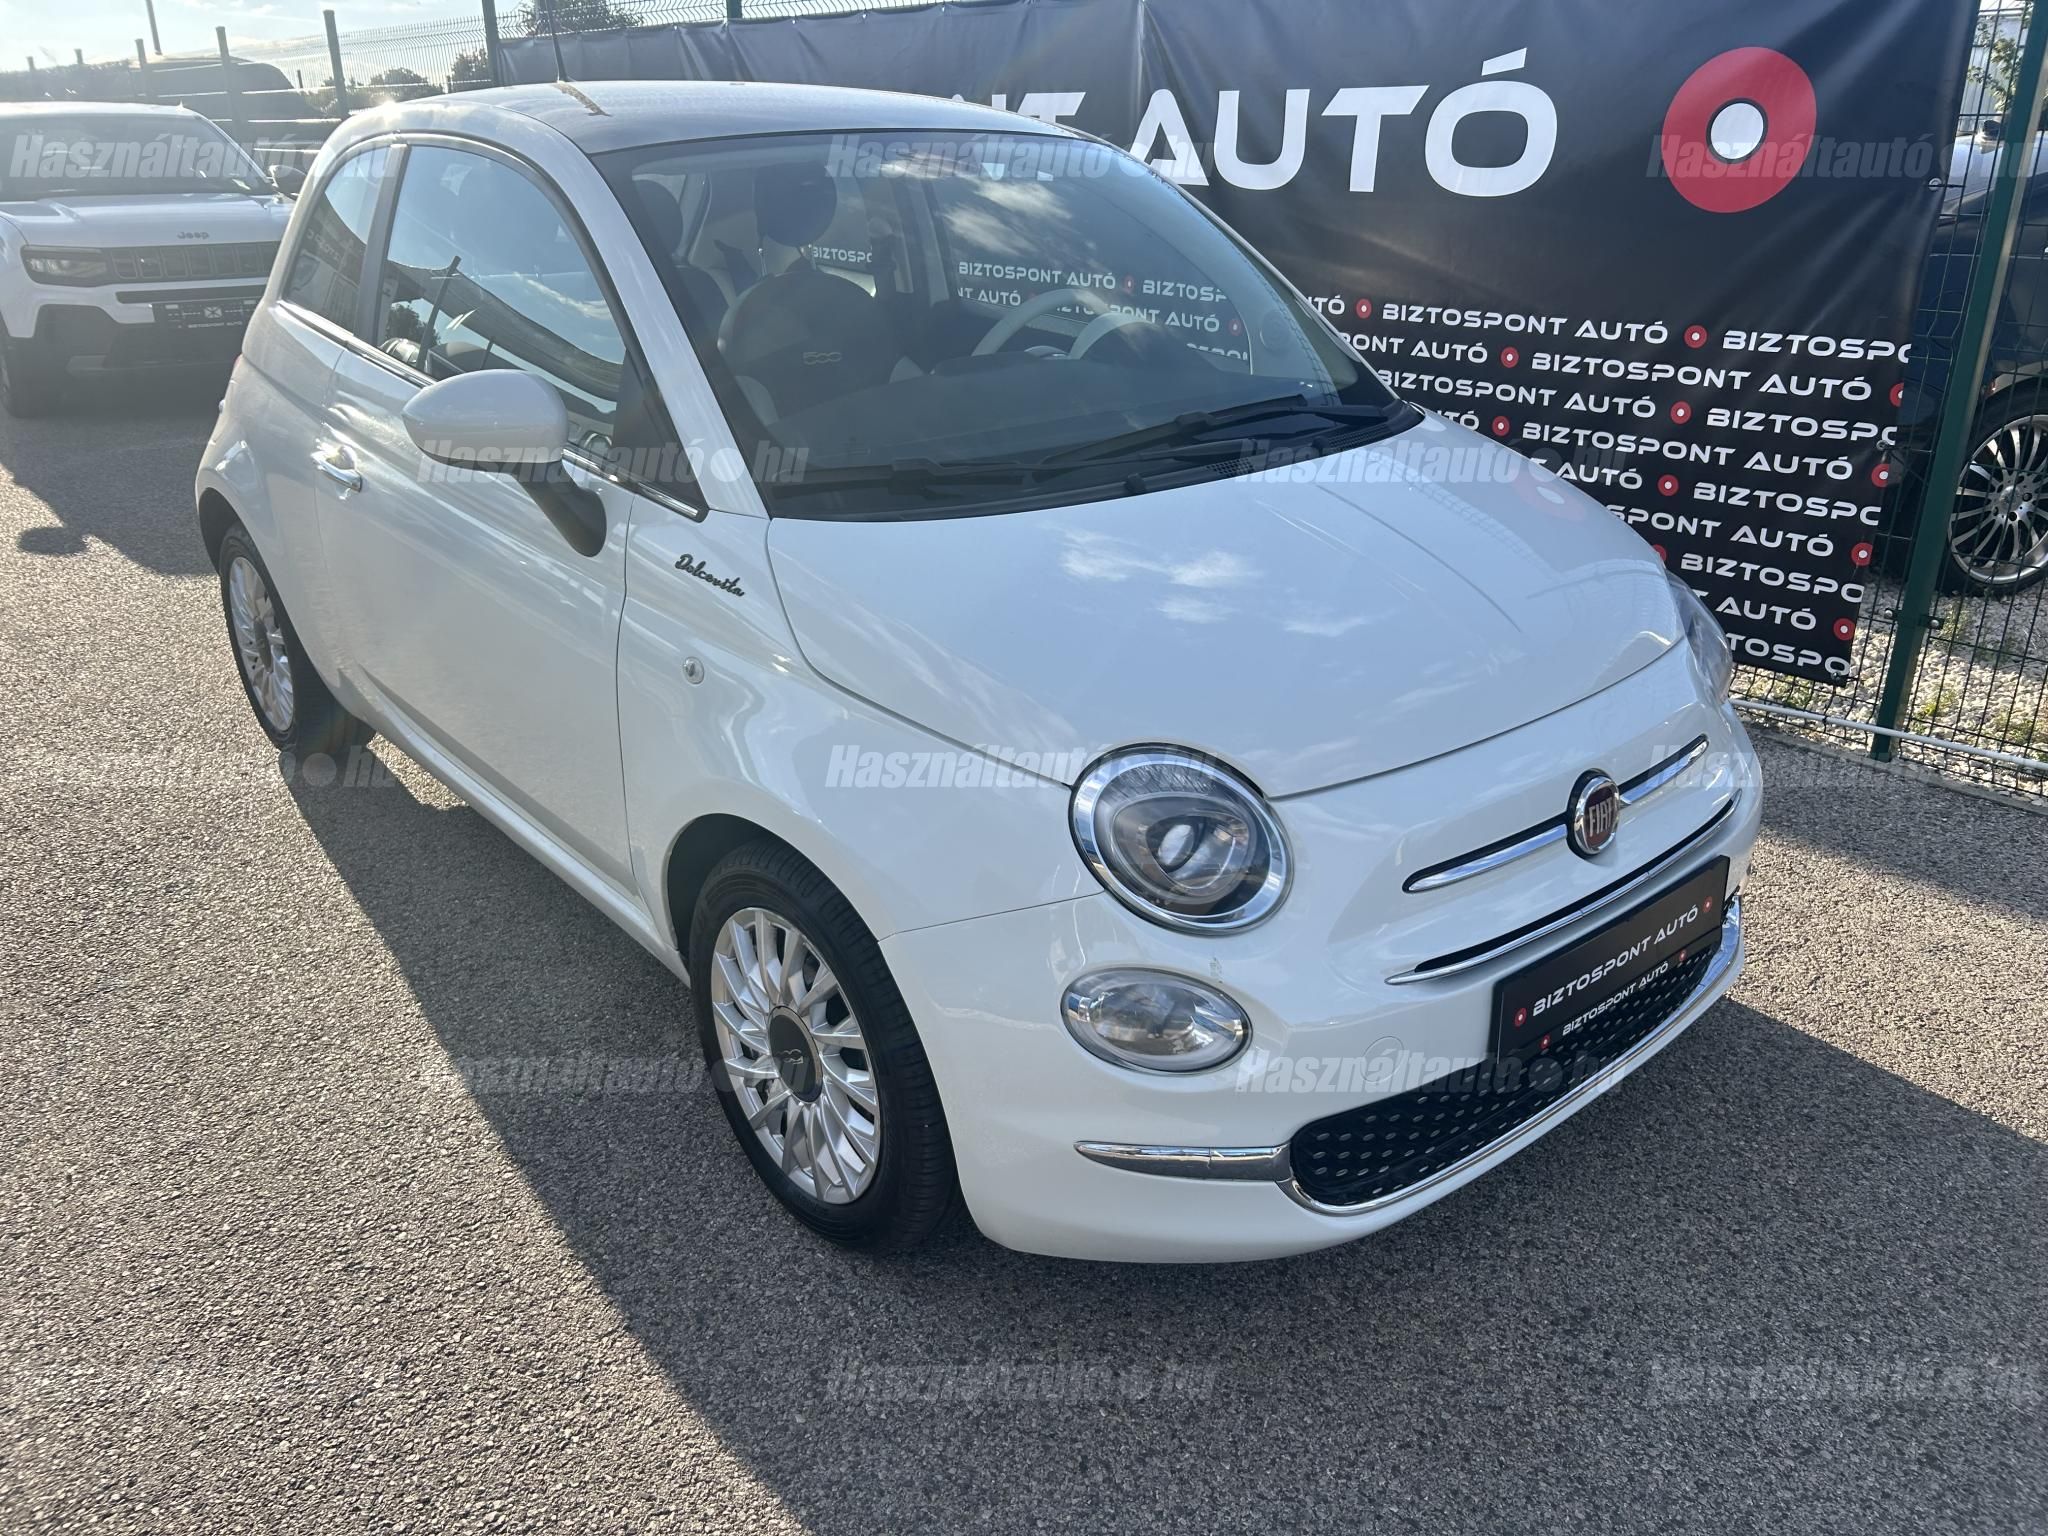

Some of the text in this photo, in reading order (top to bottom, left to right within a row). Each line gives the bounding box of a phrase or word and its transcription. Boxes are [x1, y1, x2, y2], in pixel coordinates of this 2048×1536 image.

[1128, 47, 1557, 197] AUTÓ
[958, 261, 1061, 285] BIZTOSPONT
[1066, 271, 1116, 290] AUTÓ
[977, 290, 1021, 306] AUTÓ
[1164, 313, 1220, 333] AUTÓ
[1382, 303, 1568, 336] BIZTOSPONT
[1574, 320, 1668, 344] AUTÓ
[1410, 340, 1488, 364] AUTÓ
[1532, 352, 1751, 390] BIZTOSPONT
[1758, 373, 1872, 401] AUTÓ
[1377, 369, 1557, 406] BIZTOSPONT
[1563, 392, 1656, 418] AUTÓ
[1522, 421, 1736, 466] BIZTOSPONT
[1743, 451, 1853, 480] AUTÓ
[1555, 461, 1643, 490] AUTÓ
[1729, 525, 1834, 557] AUTÓ
[674, 553, 745, 597] Dolcevita
[1715, 596, 1817, 630] AUTÓ
[1588, 796, 1618, 838] FIAT
[1532, 904, 1698, 1016] BIZTOSPONT AUTÓ
[1562, 961, 1669, 1036] BIZTOSPONT AUTÓ
